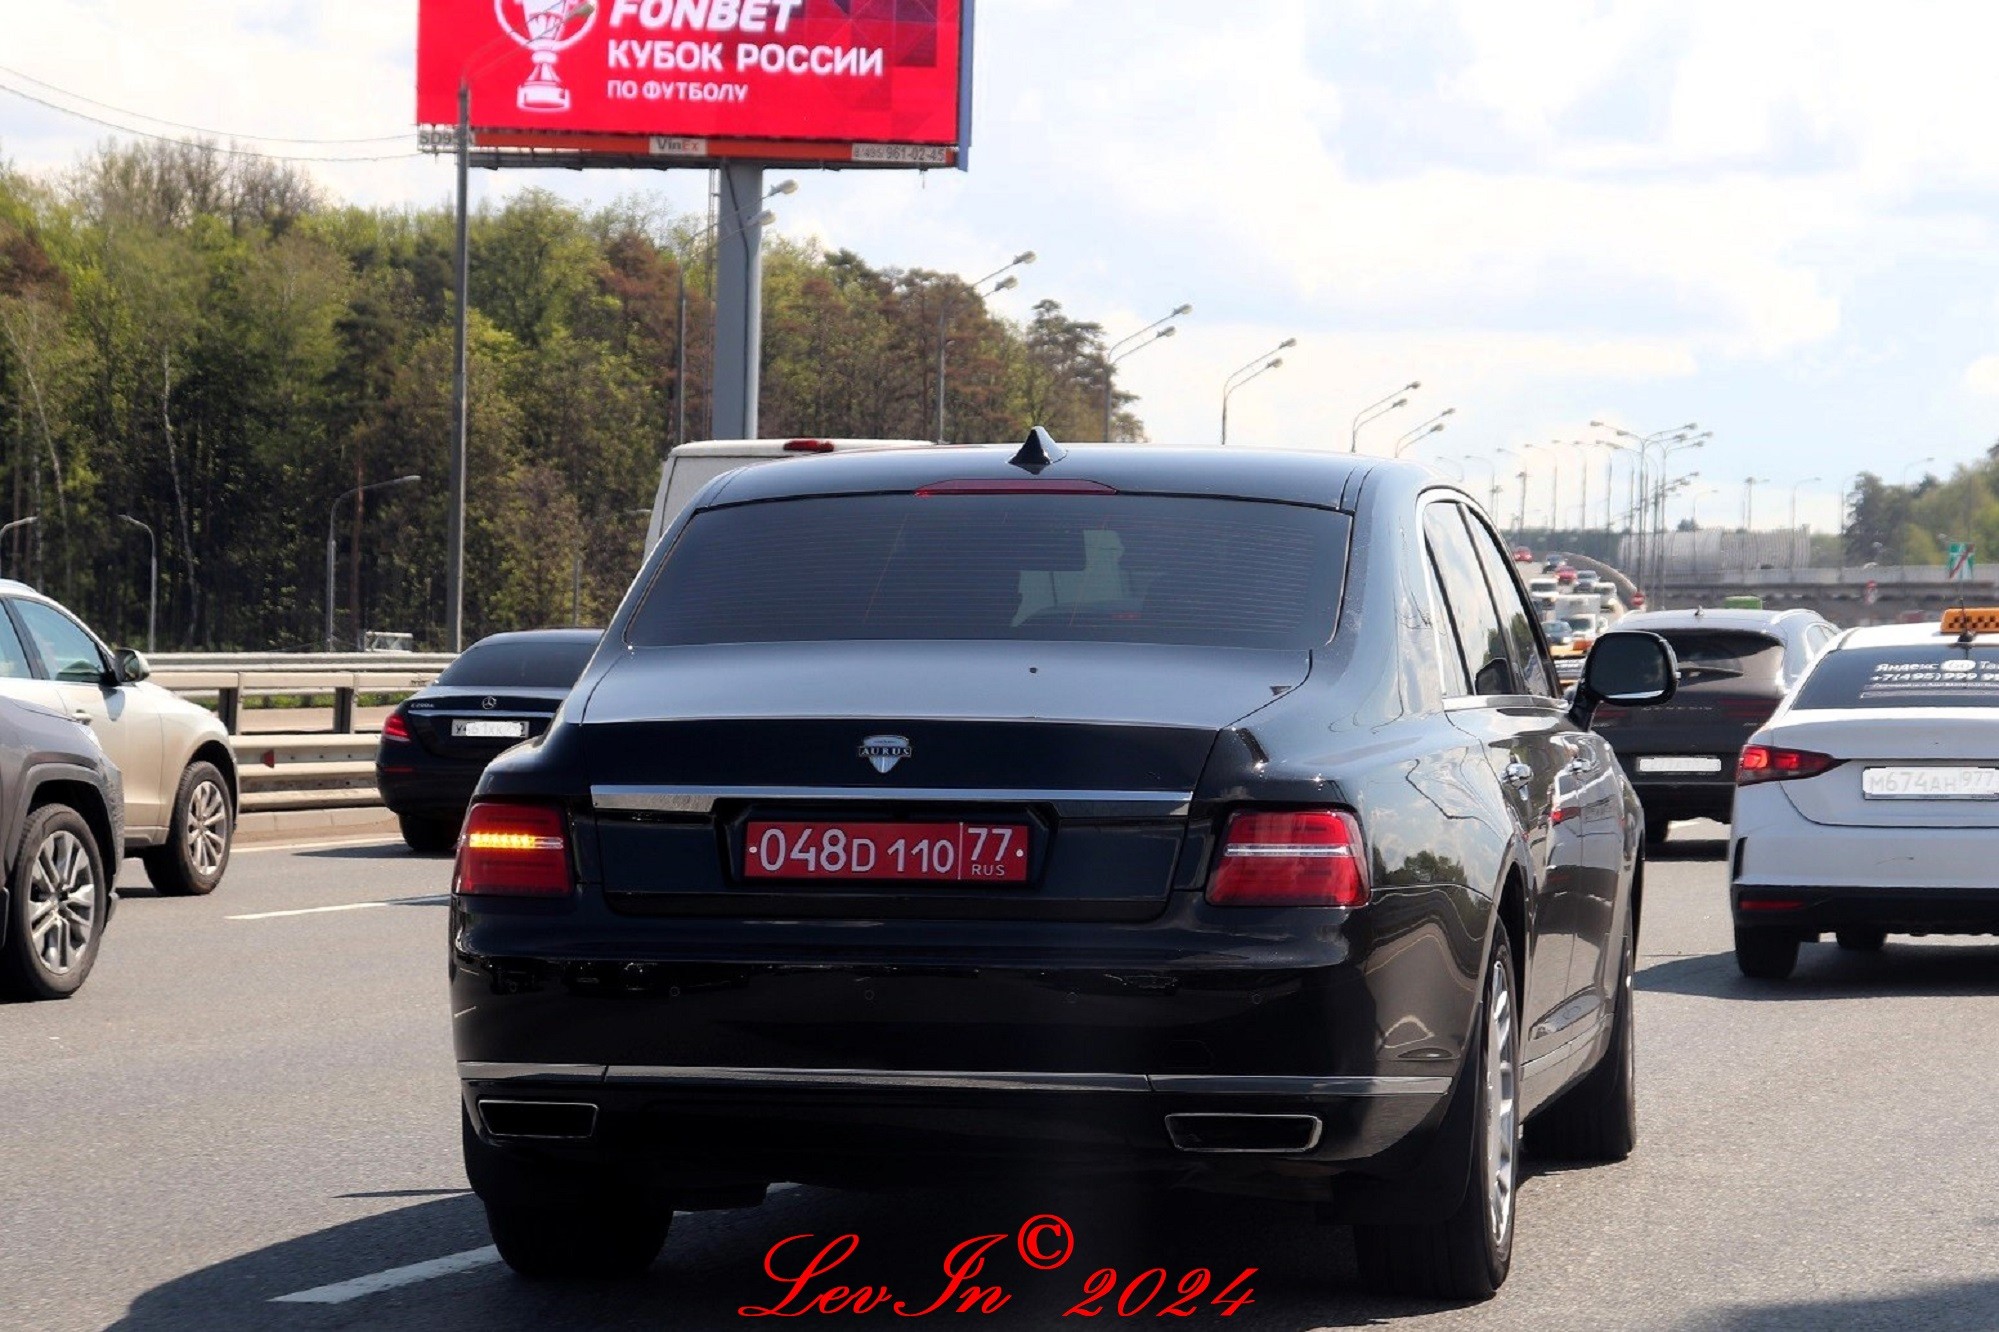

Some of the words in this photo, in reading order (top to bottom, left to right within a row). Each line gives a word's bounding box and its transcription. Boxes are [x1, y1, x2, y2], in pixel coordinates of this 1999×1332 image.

[608, 0, 806, 33] FONBET
[608, 39, 724, 72] КУБОК
[736, 43, 884, 77] РОССИИ
[607, 80, 638, 100] ПО
[642, 80, 749, 102] ФУТБОЛУ
[1875, 663, 1939, 672] Яндекс
[861, 747, 910, 756] AURUS
[760, 828, 876, 872] 048D
[887, 839, 954, 873] 110
[967, 828, 1013, 861] 77
[971, 864, 1005, 876] RUS
